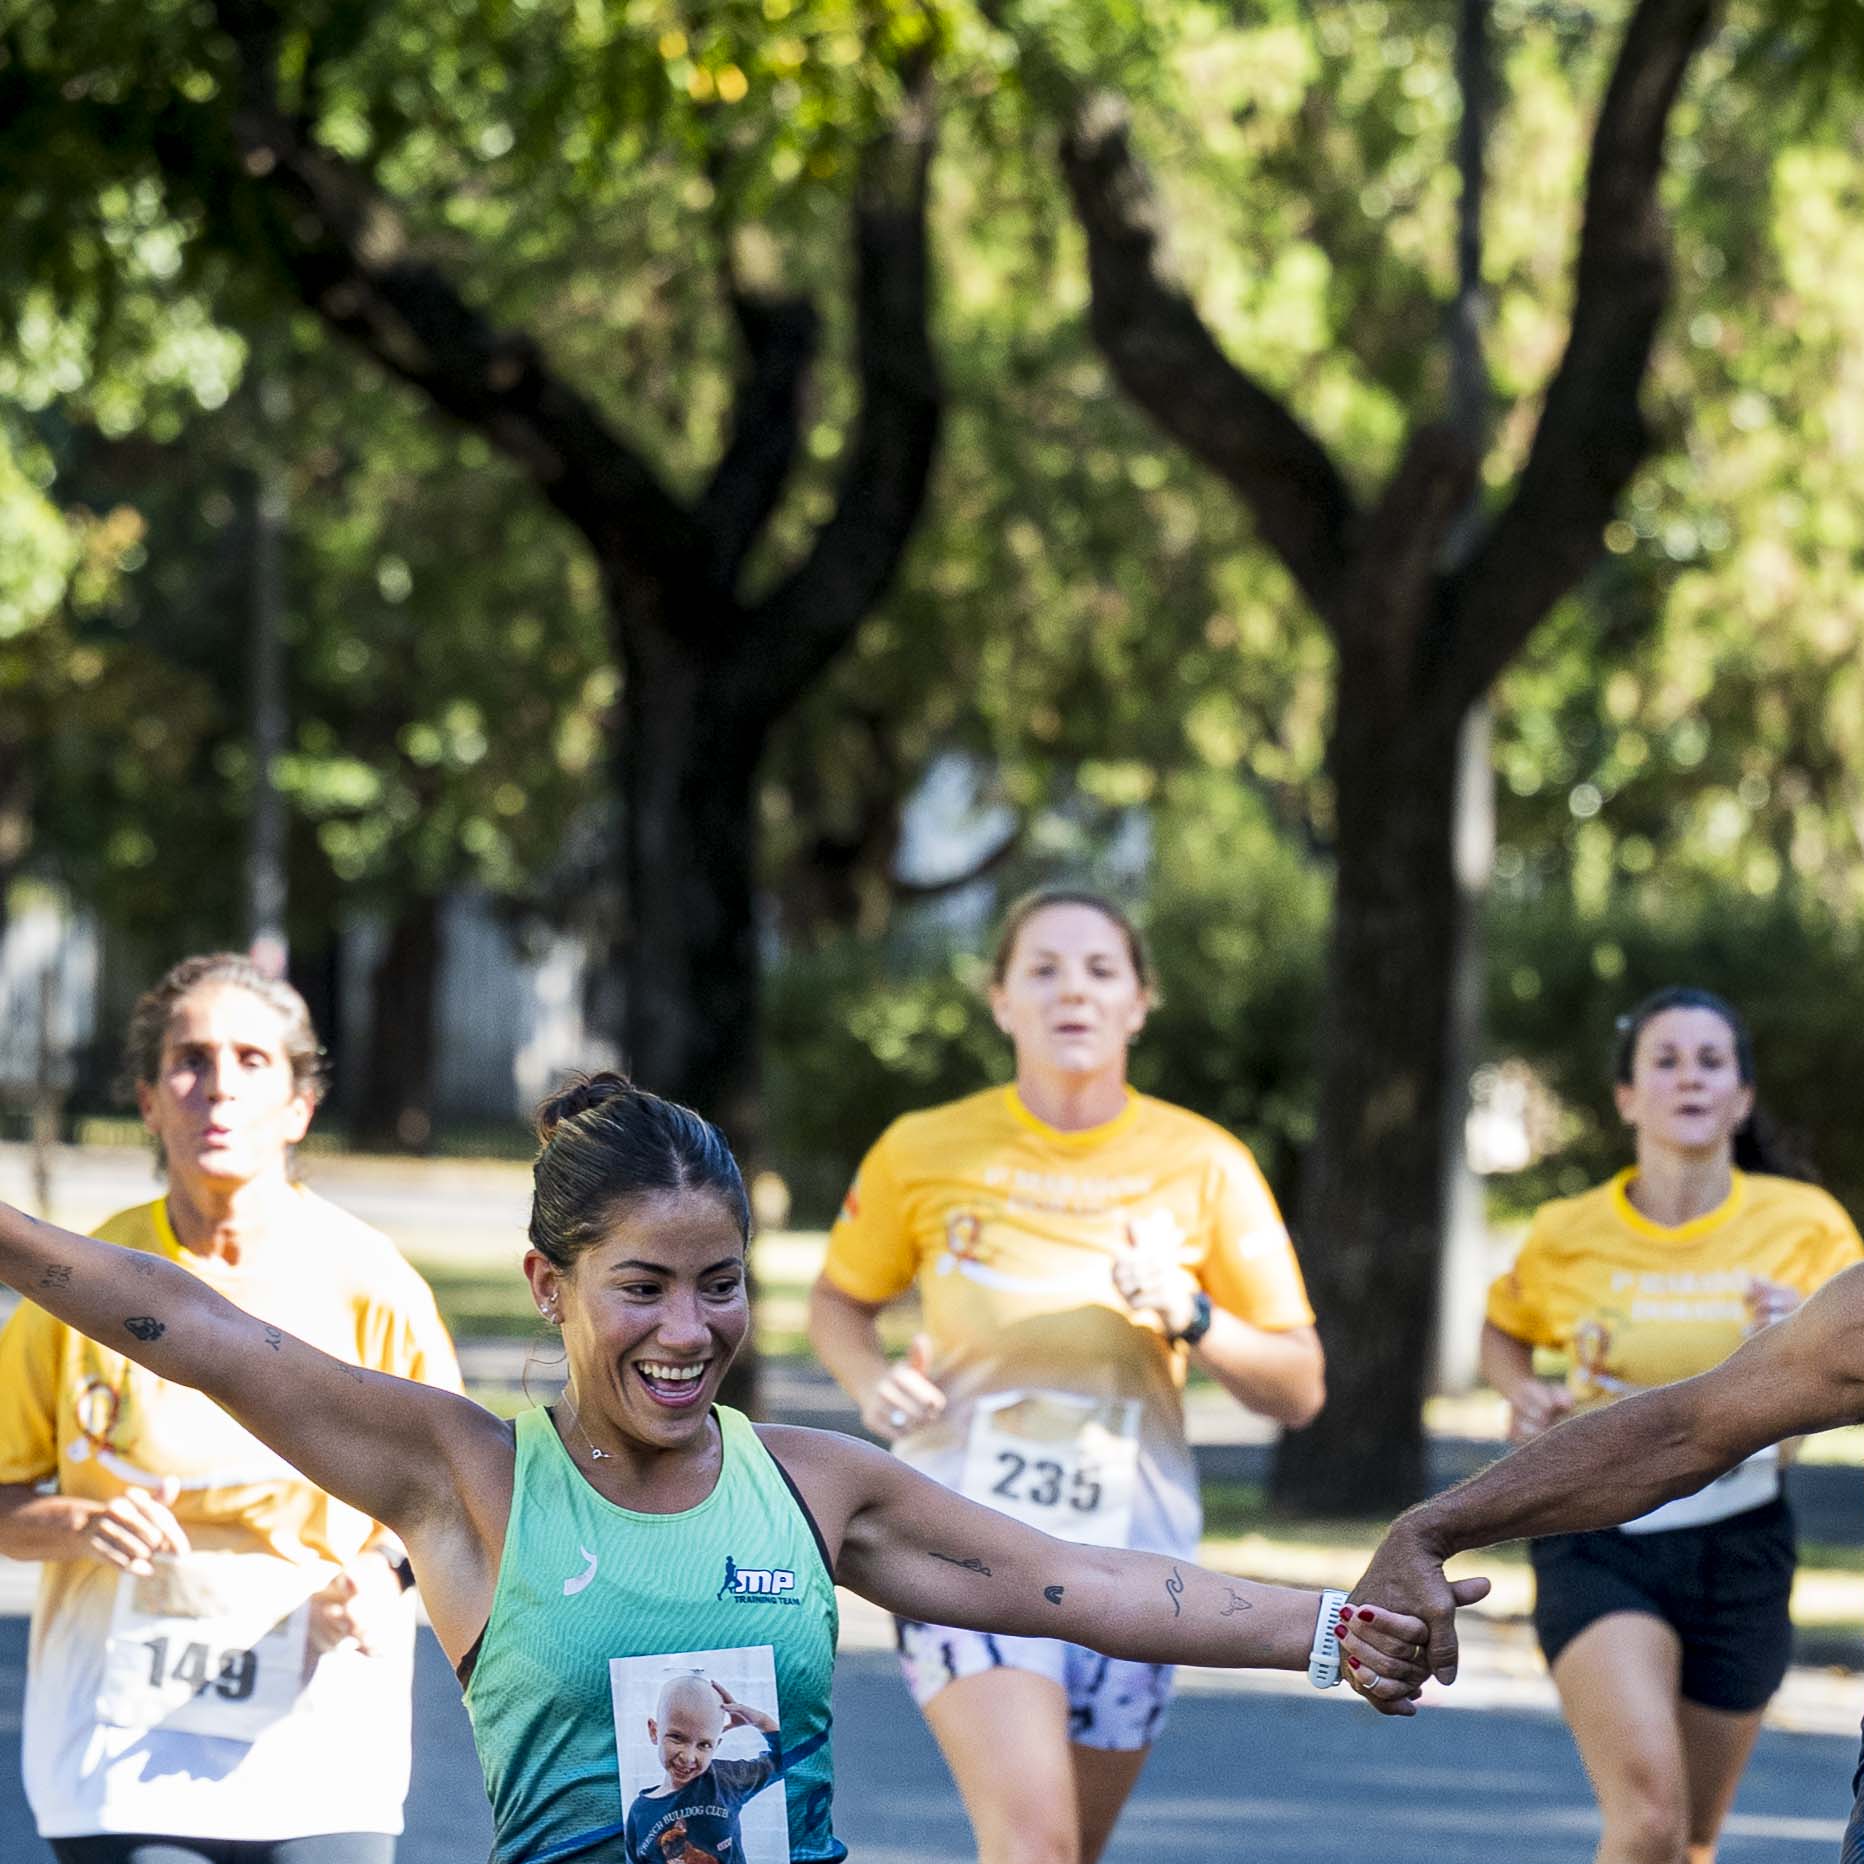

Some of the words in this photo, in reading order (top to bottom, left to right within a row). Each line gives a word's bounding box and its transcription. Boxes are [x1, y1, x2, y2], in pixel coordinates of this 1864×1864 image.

[993, 1452, 1102, 1513] 235
[734, 1569, 795, 1596] MP
[734, 1595, 777, 1604] TRAINING
[779, 1597, 801, 1606] TEAM
[143, 1636, 258, 1703] 149
[662, 1805, 704, 1825] BULLDOG
[705, 1804, 729, 1819] CLUB
